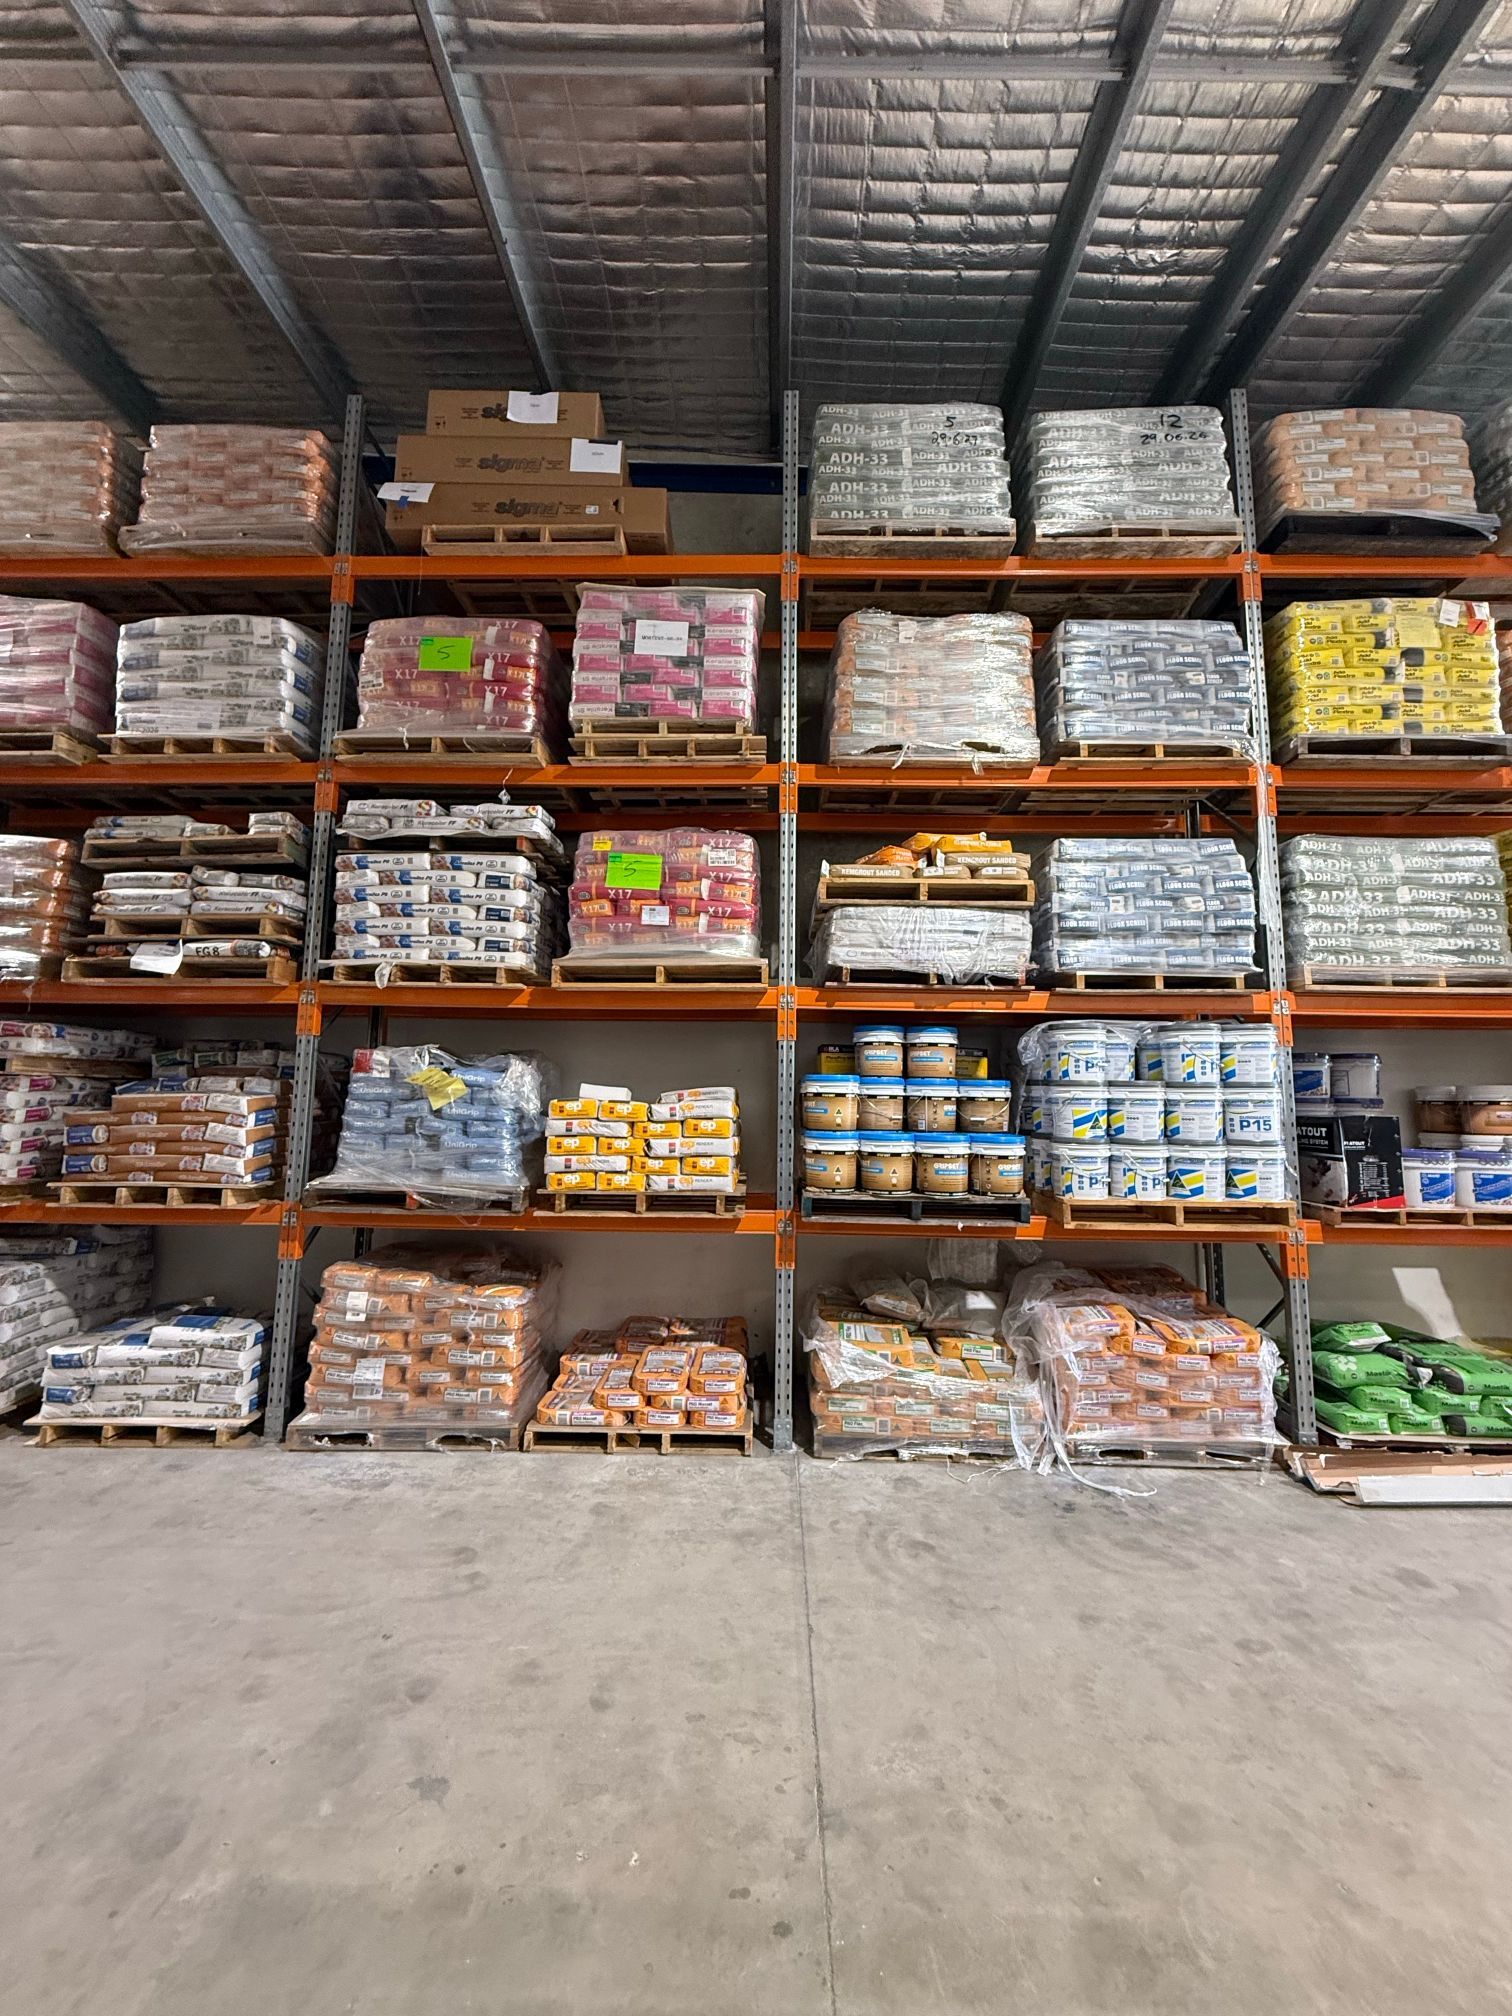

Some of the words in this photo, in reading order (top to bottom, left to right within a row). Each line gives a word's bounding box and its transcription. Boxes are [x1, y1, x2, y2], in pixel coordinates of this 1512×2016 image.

[945, 417, 956, 428] 5
[1161, 415, 1183, 428] 12
[831, 423, 888, 435] ADH-33
[819, 436, 856, 444] ADH-33
[478, 454, 542, 472] sigma
[830, 453, 888, 464] ADH-33
[819, 465, 856, 474] ADH-33
[937, 463, 996, 473] ADH-33
[830, 482, 888, 493] ADH-33
[495, 498, 559, 517] sigma
[437, 645, 455, 660] 5
[395, 669, 417, 679] X17
[485, 686, 507, 696] X17
[708, 839, 732, 847] X17
[623, 861, 641, 877] 5
[709, 872, 732, 882] X17
[1432, 873, 1496, 886] ADH-33
[608, 890, 632, 899] X17
[708, 907, 732, 916] X17
[1434, 908, 1498, 920] ADH-33
[608, 923, 632, 932] X17
[1320, 923, 1385, 935] ADH-33
[1310, 938, 1351, 947] ADH-33
[454, 1074, 485, 1082] UniGrip
[565, 1102, 581, 1112] ep
[616, 1104, 632, 1115] ep
[447, 1109, 479, 1117] UniGrip
[650, 1123, 665, 1133] ep
[701, 1121, 716, 1132] ep
[1240, 1120, 1271, 1131] P15
[1297, 1127, 1327, 1136] ATOUT
[564, 1139, 579, 1148] ep
[614, 1140, 630, 1150] ep
[648, 1159, 663, 1169] ep
[700, 1158, 715, 1169] ep
[564, 1174, 580, 1184] ep
[614, 1176, 629, 1186] ep
